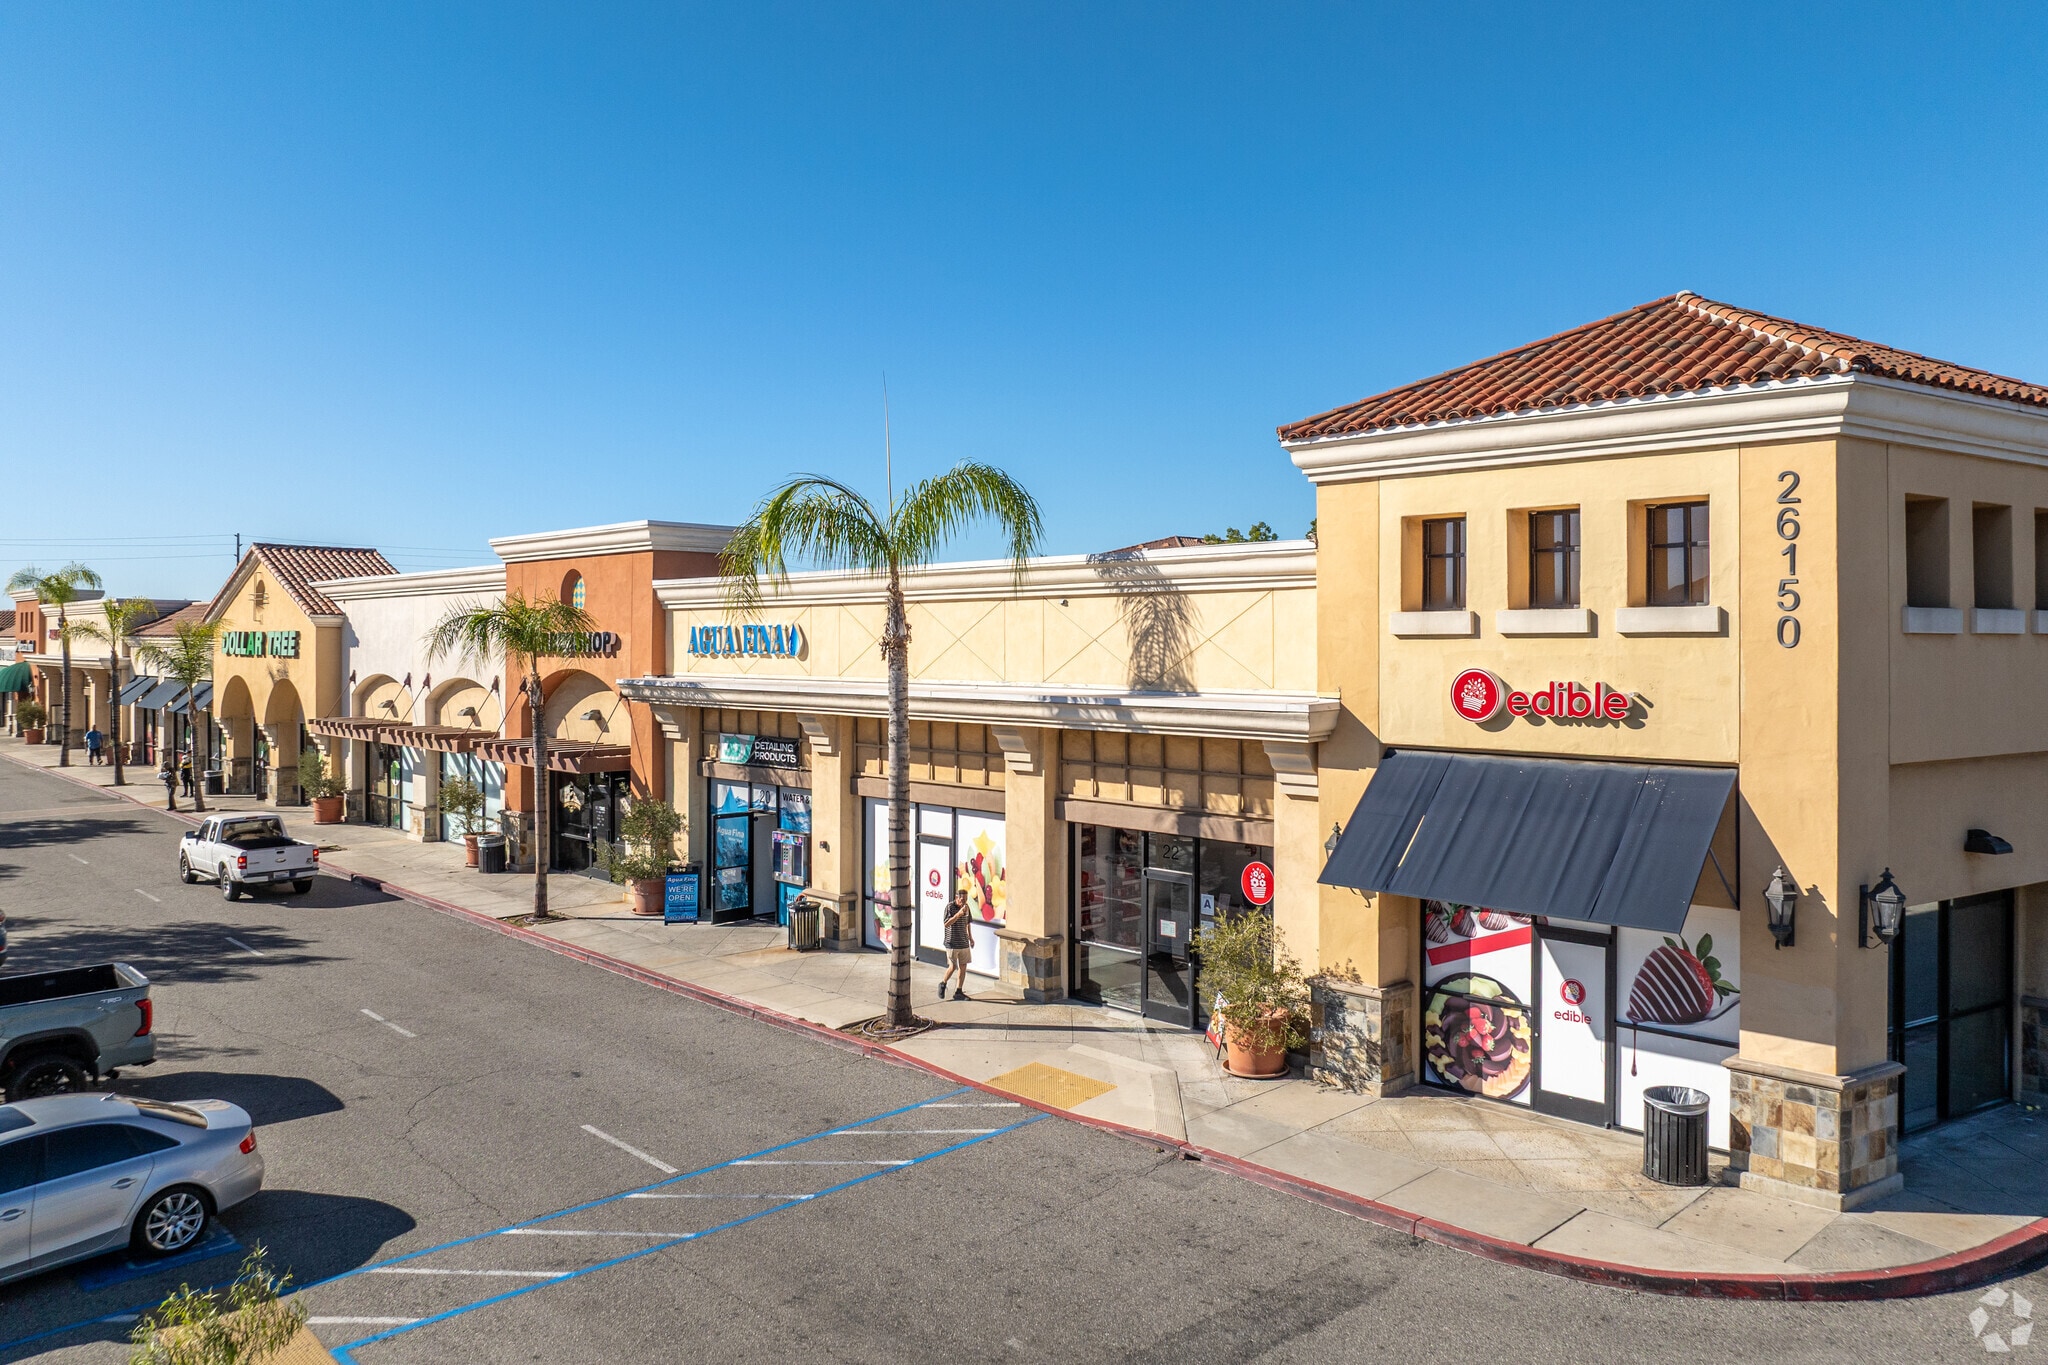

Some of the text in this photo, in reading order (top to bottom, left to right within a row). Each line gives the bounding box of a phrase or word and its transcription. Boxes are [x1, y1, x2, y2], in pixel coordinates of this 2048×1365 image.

[1776, 470, 1802, 649] 26150
[221, 630, 296, 656] DOLLAR TREE
[687, 623, 787, 654] AGUA FINA
[1506, 680, 1630, 720] edible
[754, 741, 794, 752] DETAILING
[754, 751, 797, 763] PRODUCTS
[759, 789, 771, 804] 20
[782, 792, 810, 804] WATER &
[717, 826, 745, 839] Agua Fina
[1162, 844, 1180, 860] 22
[668, 885, 694, 893] WE'RE
[925, 889, 944, 900] edible
[1203, 899, 1212, 909] A
[1554, 1009, 1592, 1025] edible
